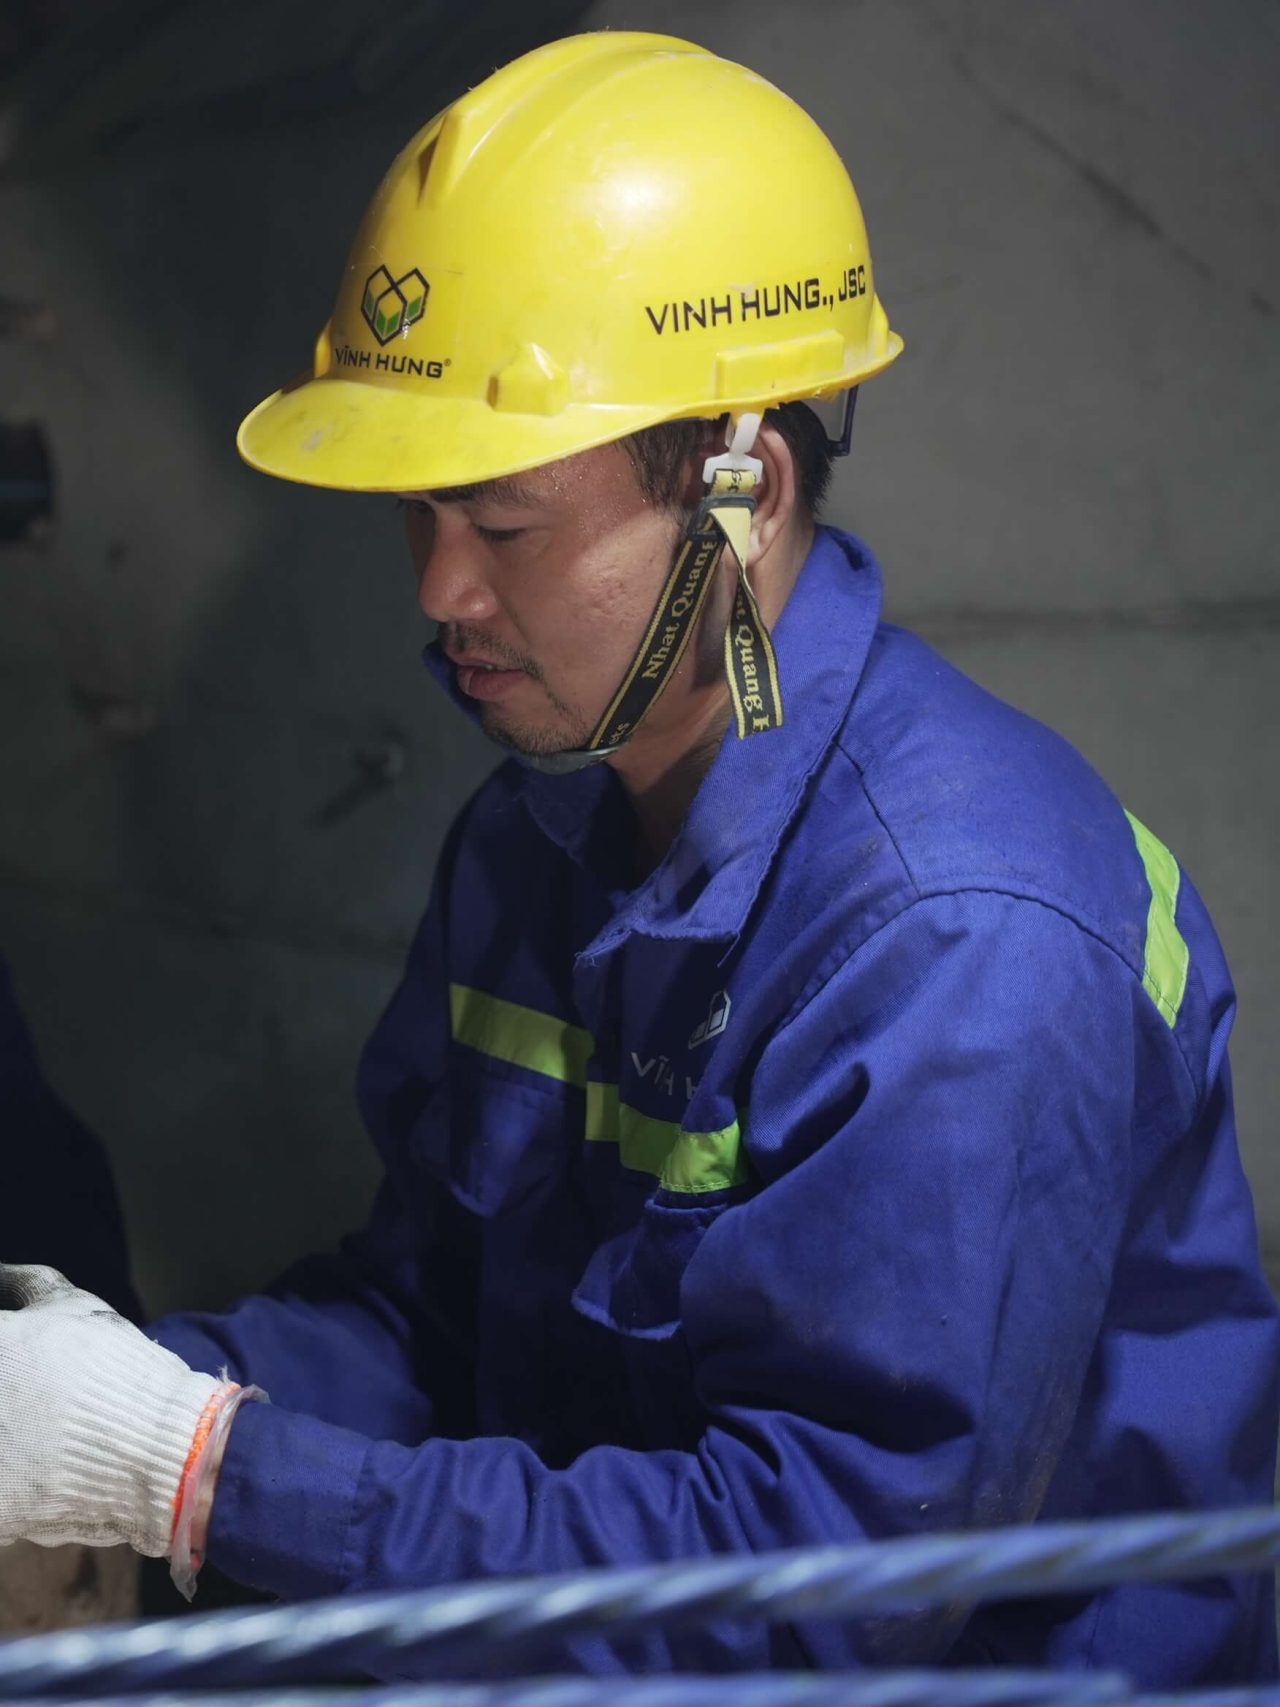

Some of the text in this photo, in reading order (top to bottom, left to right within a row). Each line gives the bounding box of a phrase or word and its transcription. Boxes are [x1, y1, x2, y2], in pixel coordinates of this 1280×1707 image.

[644, 294, 733, 335] VINH
[838, 264, 867, 302] JSC
[643, 621, 680, 679] Nhat
[734, 623, 764, 712] Quang
